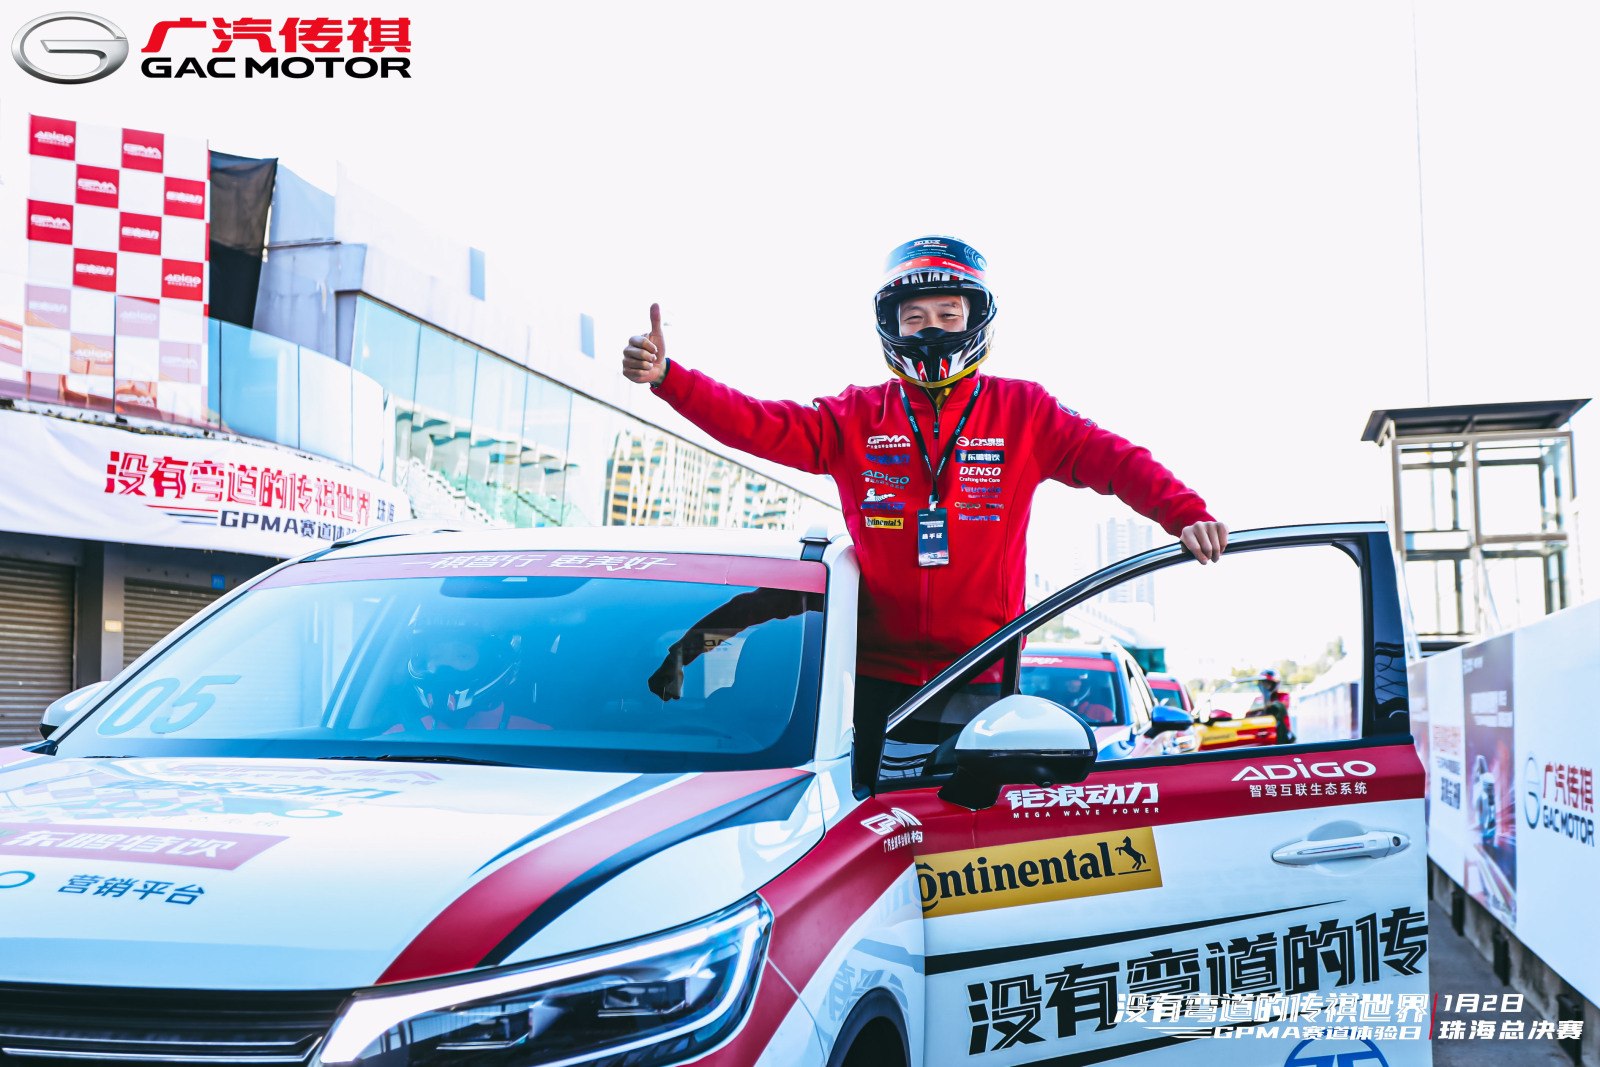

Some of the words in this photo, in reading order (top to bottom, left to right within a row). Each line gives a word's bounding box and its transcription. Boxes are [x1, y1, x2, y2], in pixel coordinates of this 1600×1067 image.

[959, 467, 1001, 476] DENSO
[104, 450, 372, 526] 没有弯道的传祺世界
[96, 674, 242, 736] 05
[1232, 758, 1376, 782] ADiGO
[1249, 782, 1368, 798] 智驾互联生态系统
[1543, 760, 1594, 814] 广汽传祺
[1013, 811, 1051, 819] MEGA
[1063, 809, 1101, 817] WAVE
[1112, 807, 1160, 815] POWER
[1, 830, 238, 858] 东鹏特饮
[57, 874, 206, 905] 营销平台
